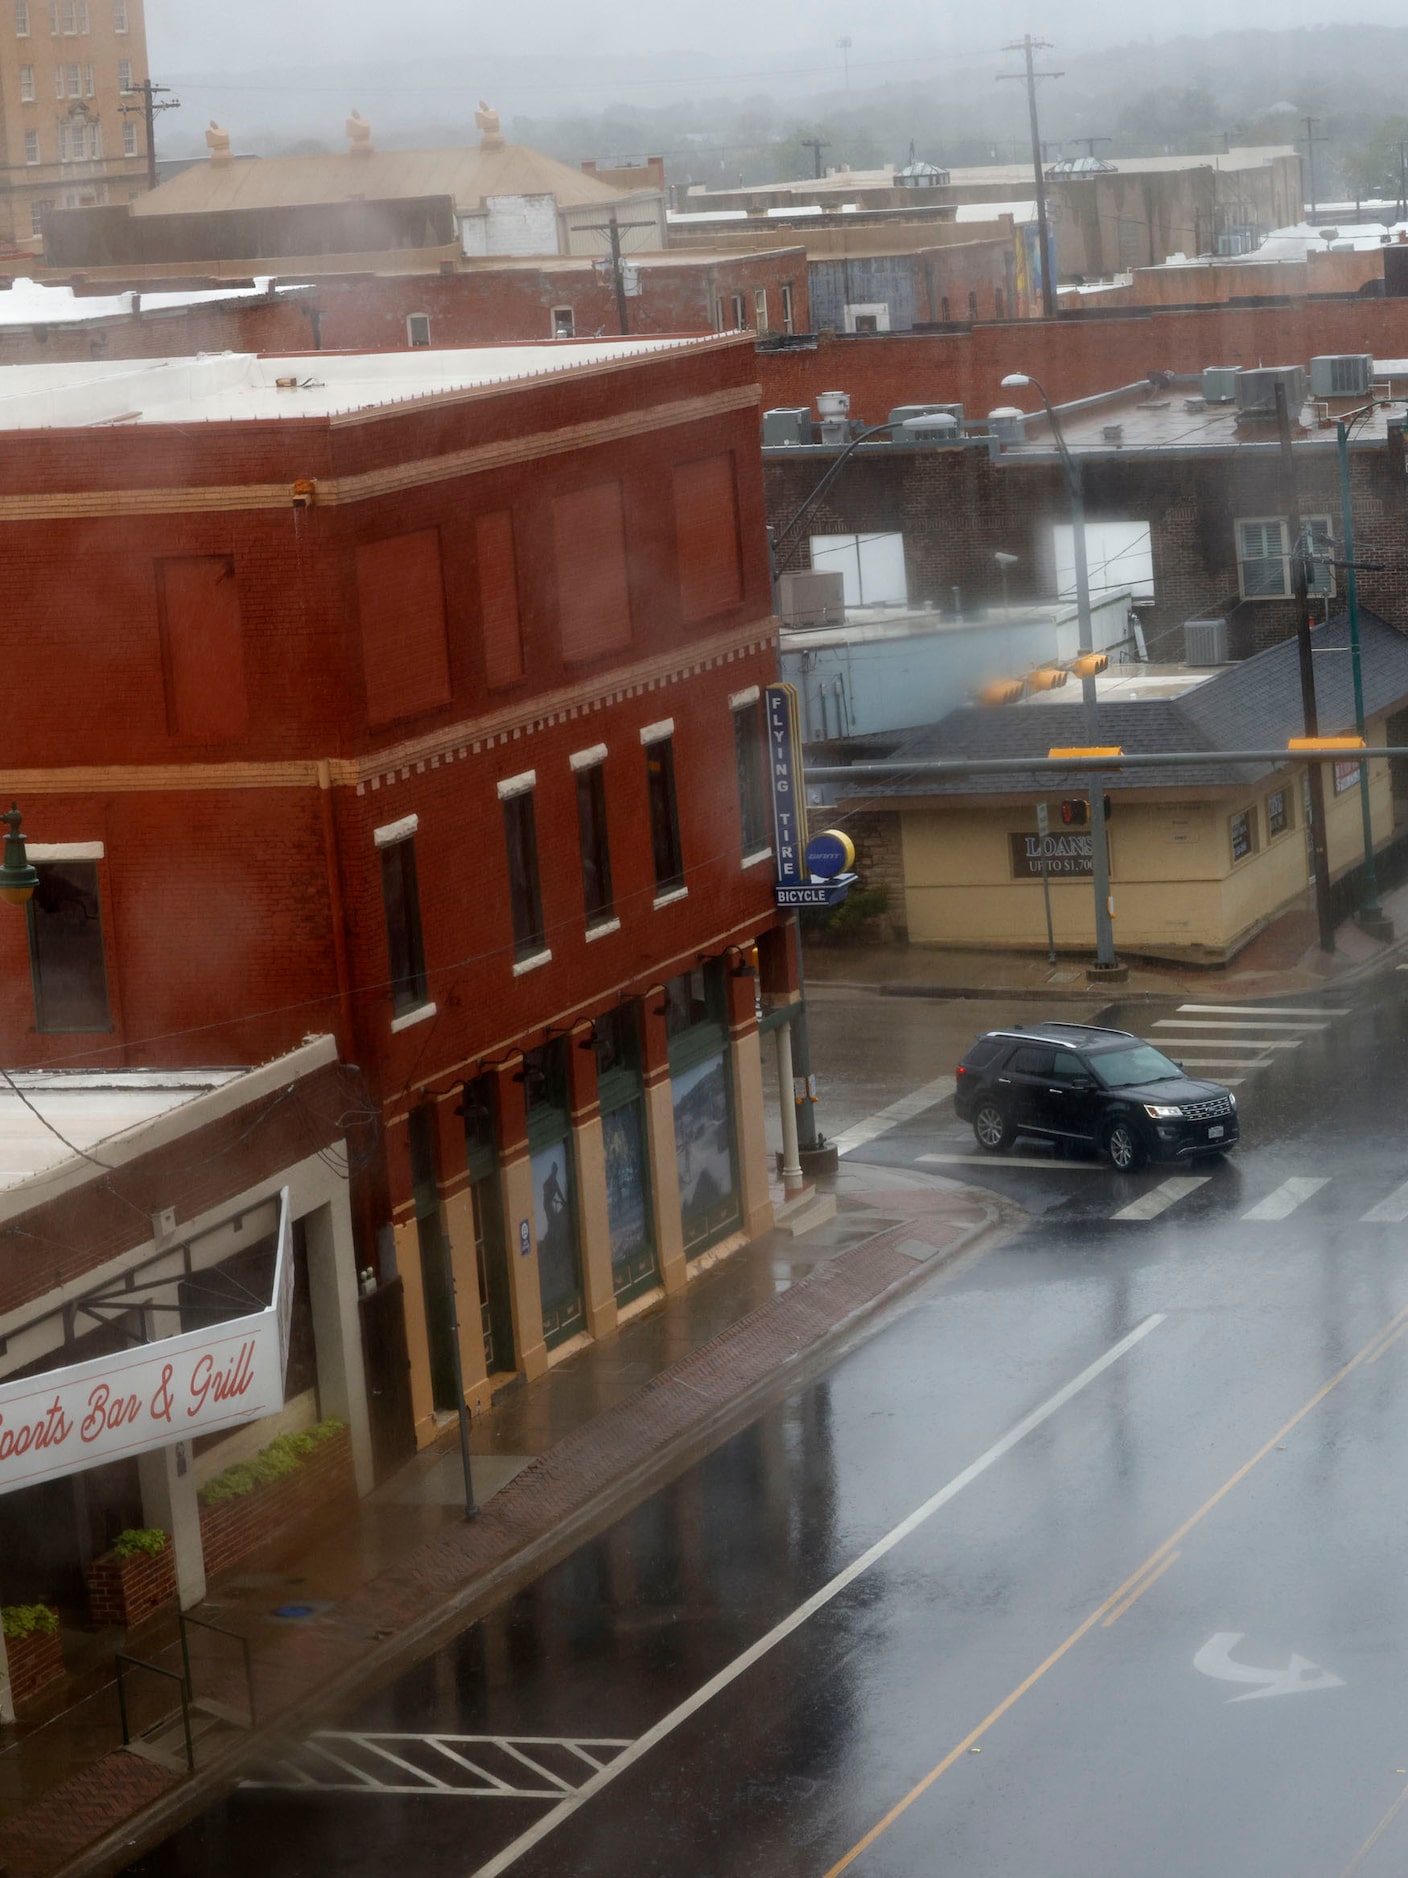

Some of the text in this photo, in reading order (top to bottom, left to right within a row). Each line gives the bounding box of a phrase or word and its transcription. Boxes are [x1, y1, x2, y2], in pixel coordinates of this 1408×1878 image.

[771, 697, 794, 875] FLYING TIRE
[1025, 836, 1094, 857] LOANS
[1047, 860, 1062, 871] TO
[777, 890, 826, 902] BICYCLE
[0, 1340, 256, 1461] ports Bar & Grill
